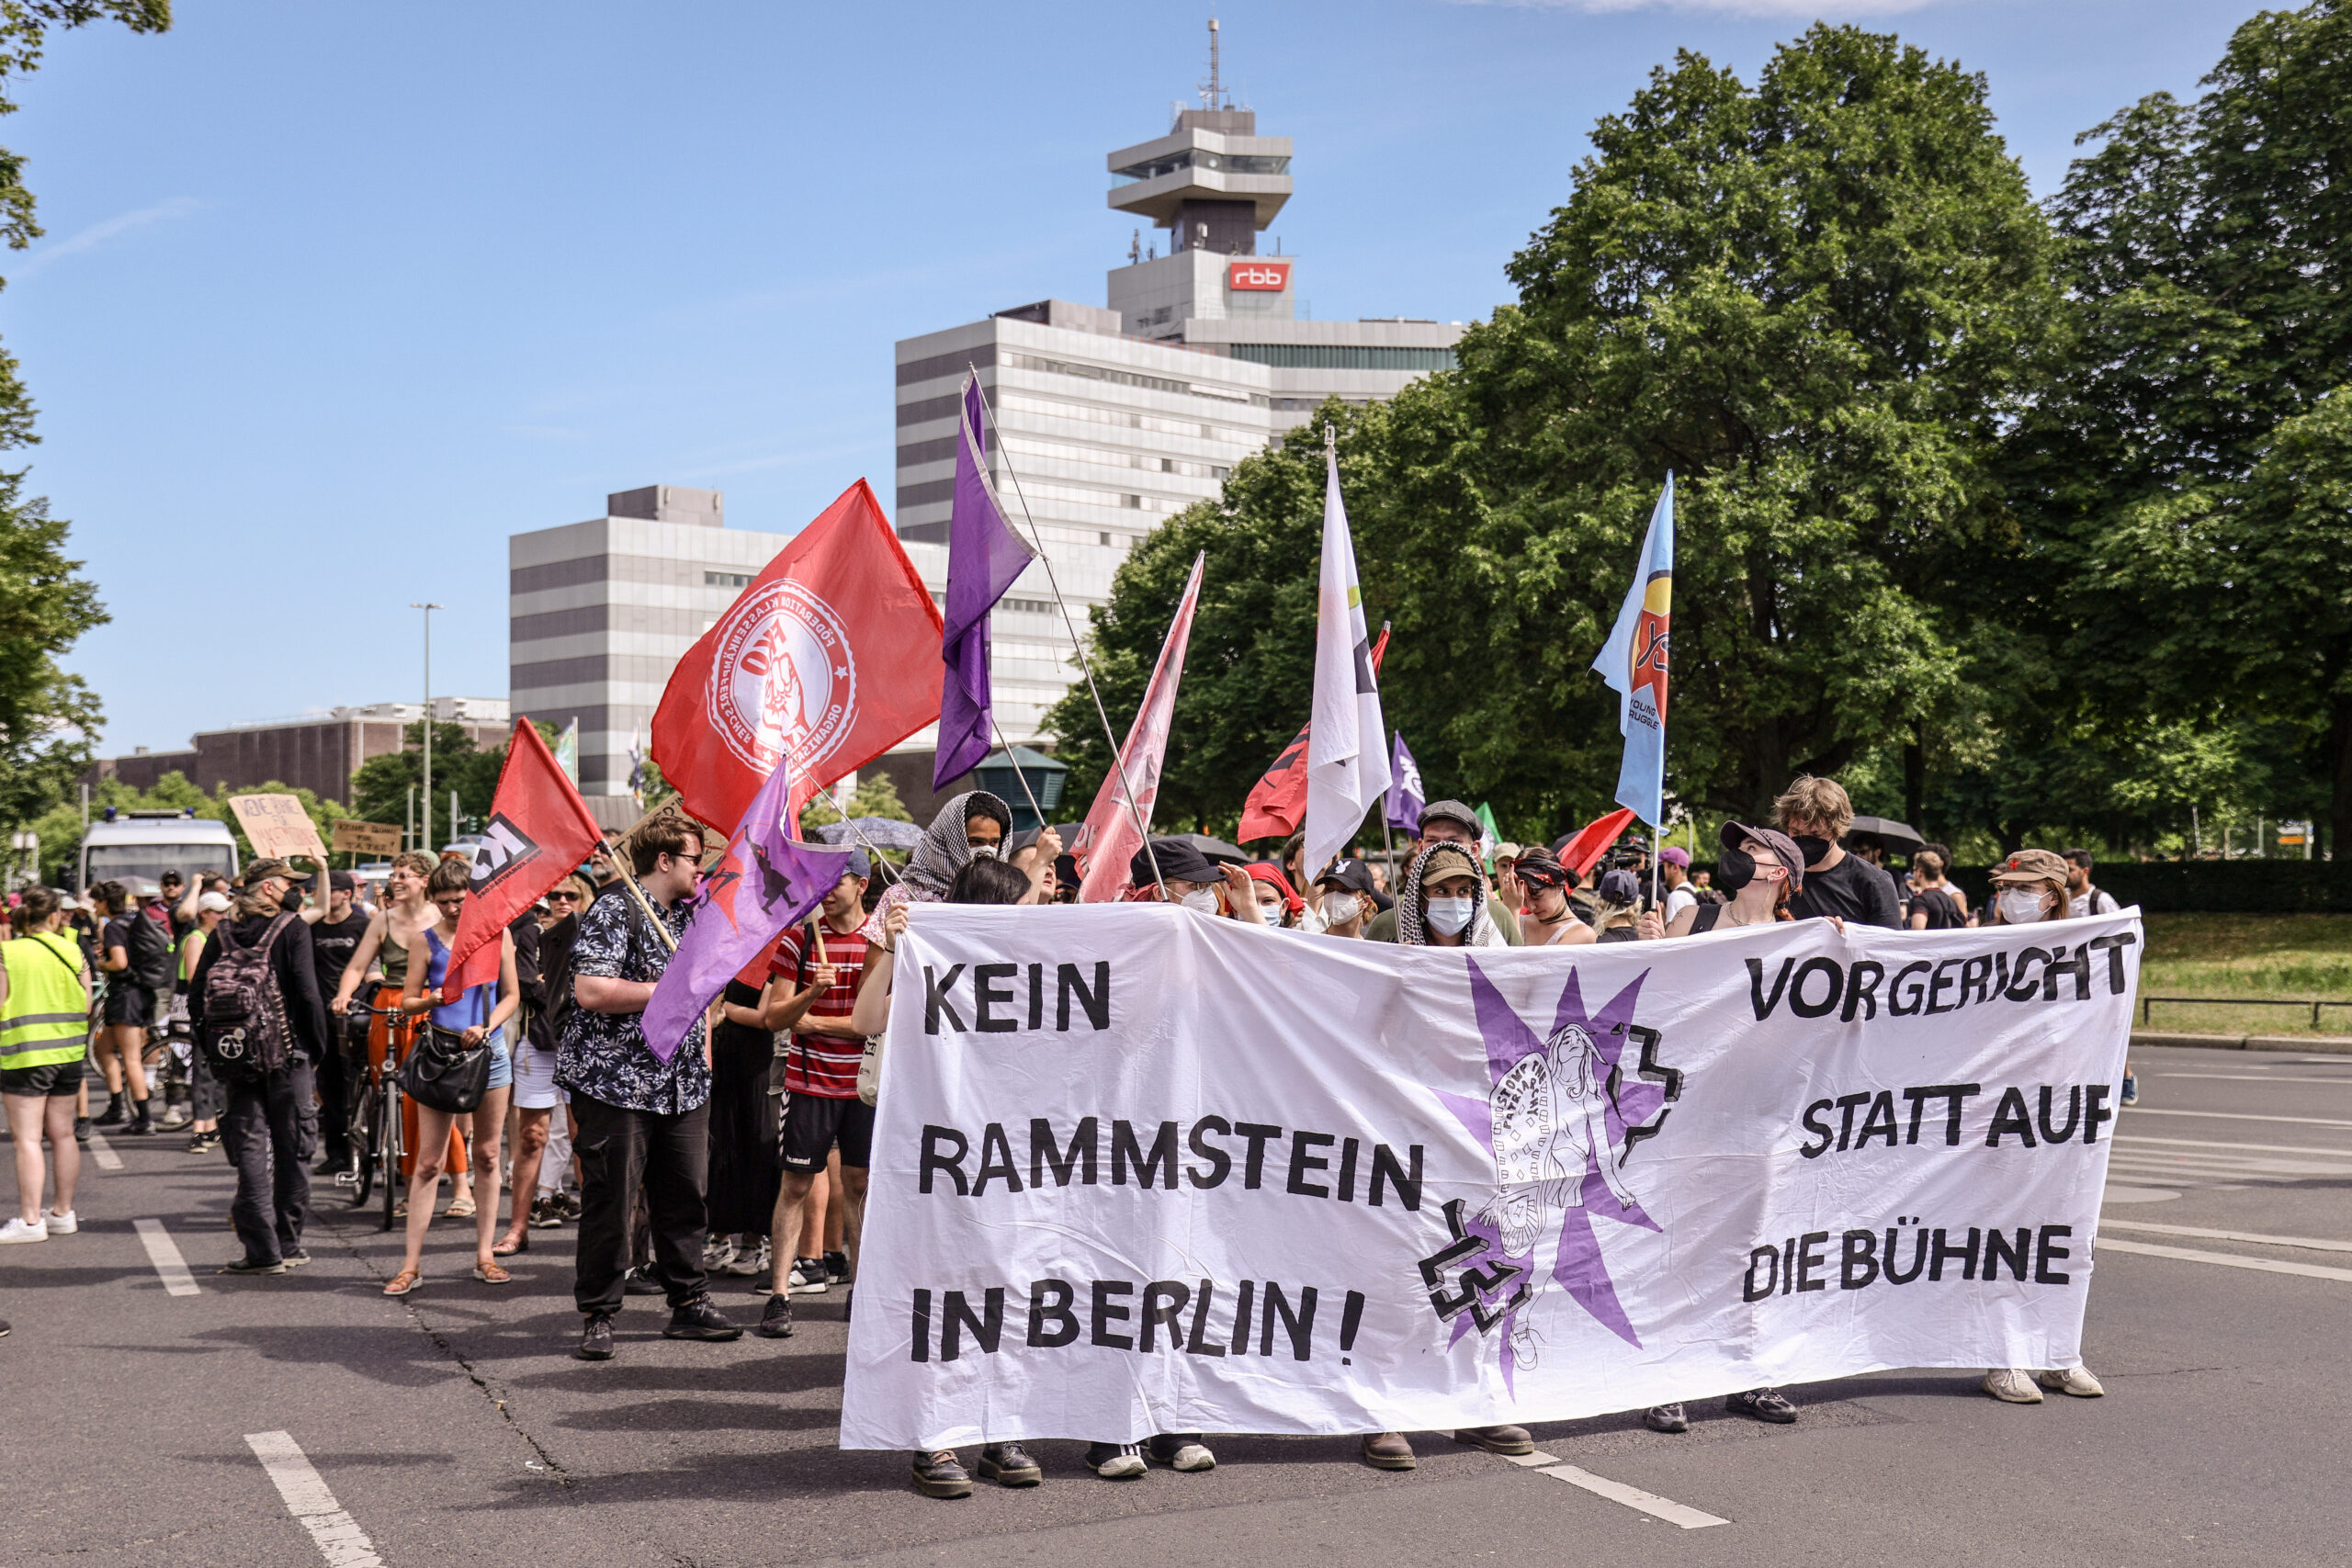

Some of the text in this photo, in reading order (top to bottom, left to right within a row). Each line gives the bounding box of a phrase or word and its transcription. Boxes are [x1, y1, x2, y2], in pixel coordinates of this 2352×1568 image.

[1235, 268, 1282, 285] rbb
[1629, 710, 1659, 730] RUGGLE
[923, 961, 1110, 1035] KEIN
[1497, 1060, 1547, 1106] STOMP THE
[1503, 1077, 1540, 1130] PATRIARCHY
[1800, 1083, 2112, 1158] STATT AUF
[919, 1115, 1423, 1212] RAMMSTEIN
[910, 1288, 1005, 1363] IN
